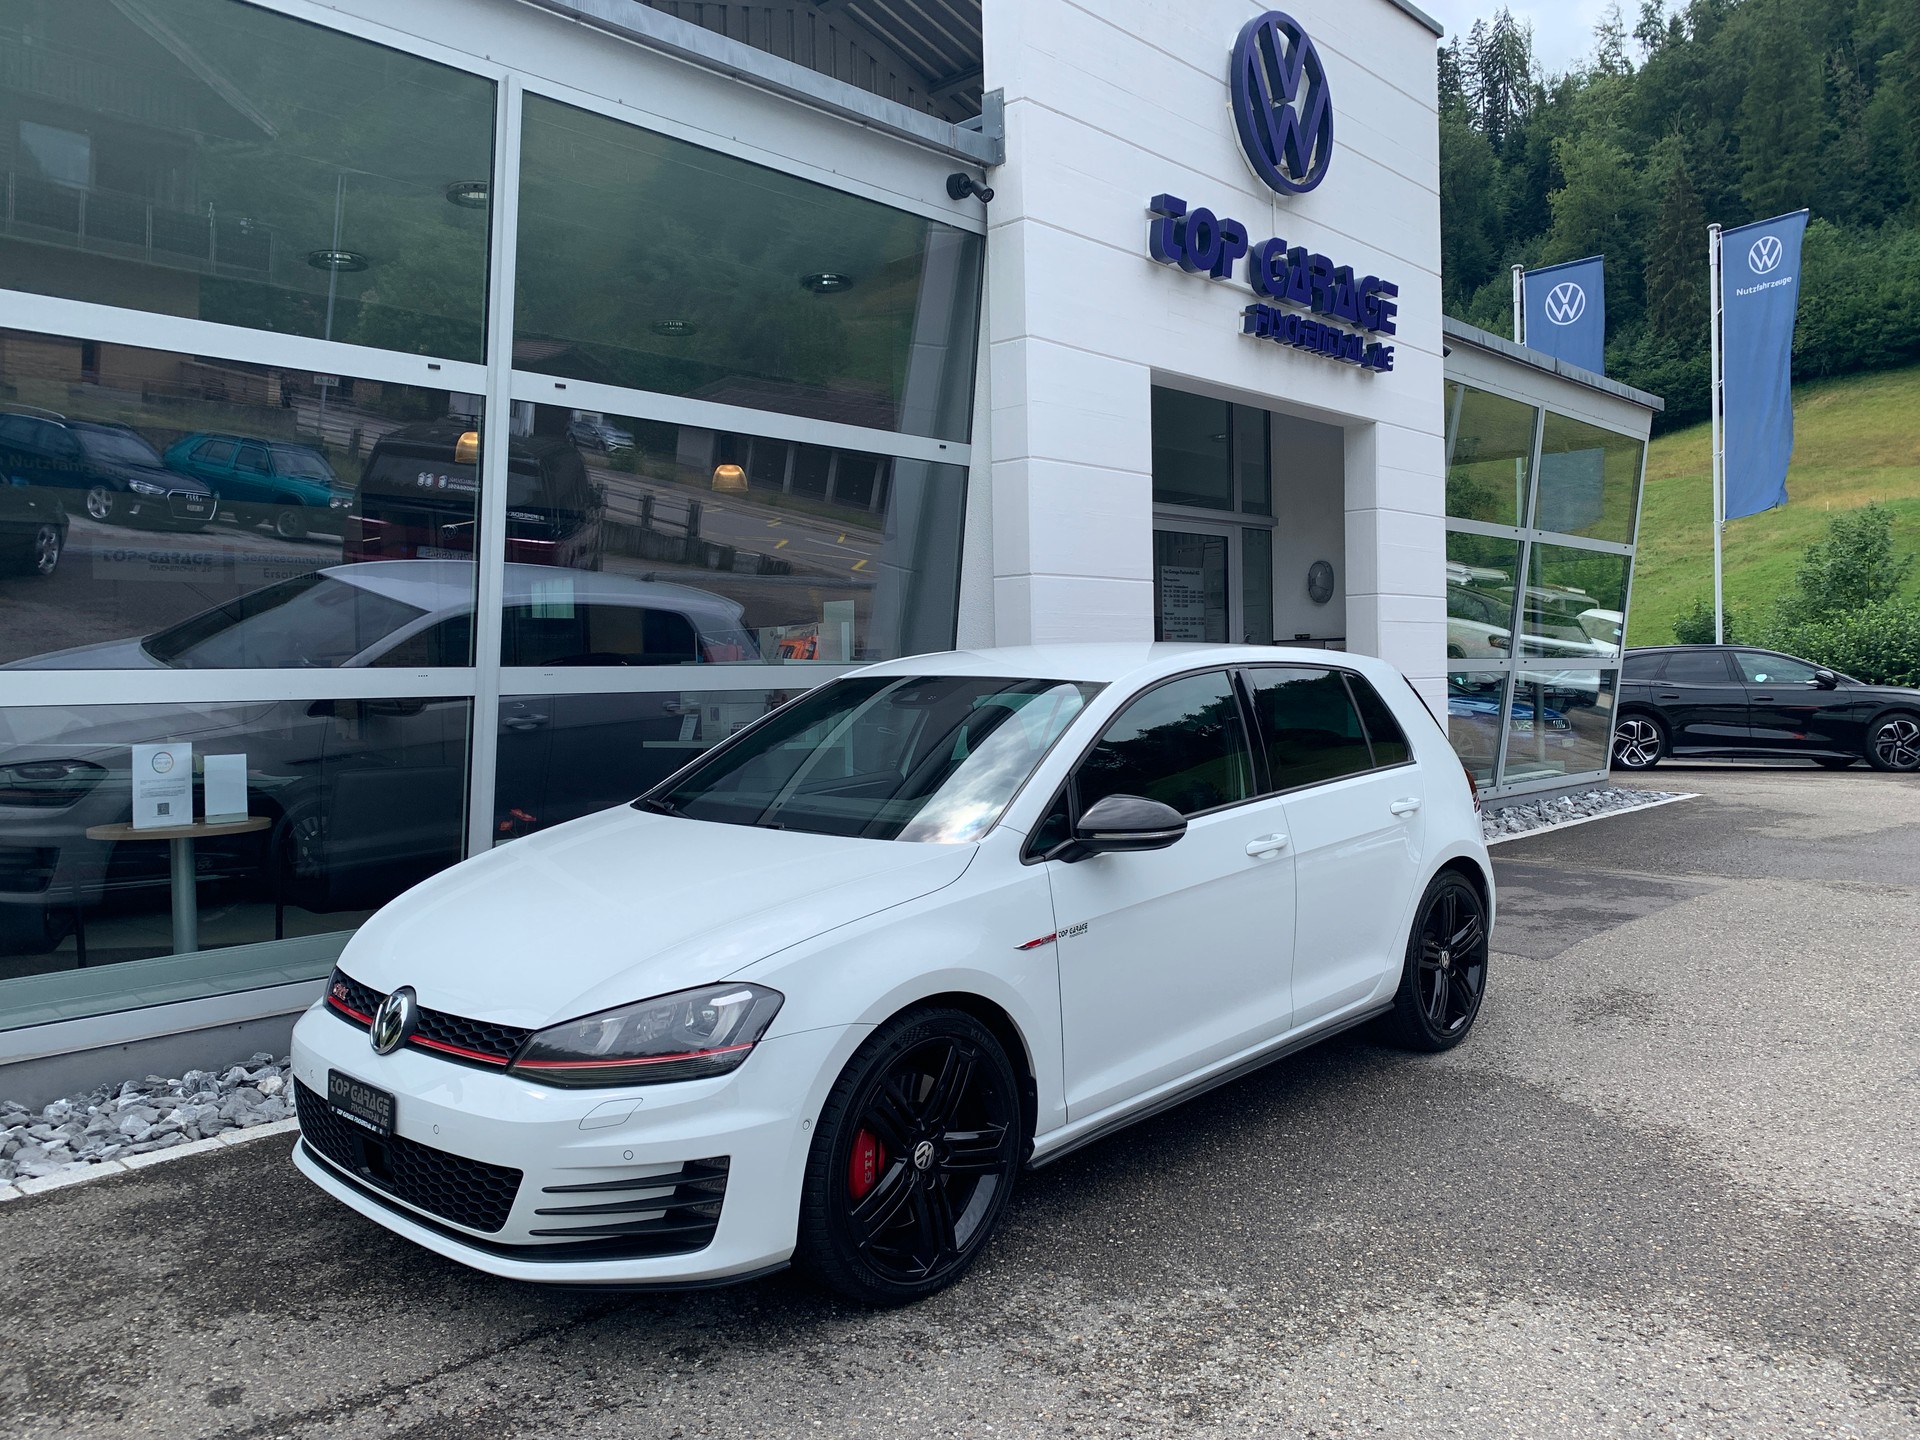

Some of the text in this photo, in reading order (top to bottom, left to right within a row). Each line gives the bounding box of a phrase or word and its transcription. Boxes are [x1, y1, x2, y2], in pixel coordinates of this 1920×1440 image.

[1150, 193, 1399, 337] TOP GARAGE
[1735, 274, 1793, 297] Nutzfahrzeuge
[329, 1075, 391, 1117] TOP GARAGE
[864, 1149, 873, 1184] GTI
